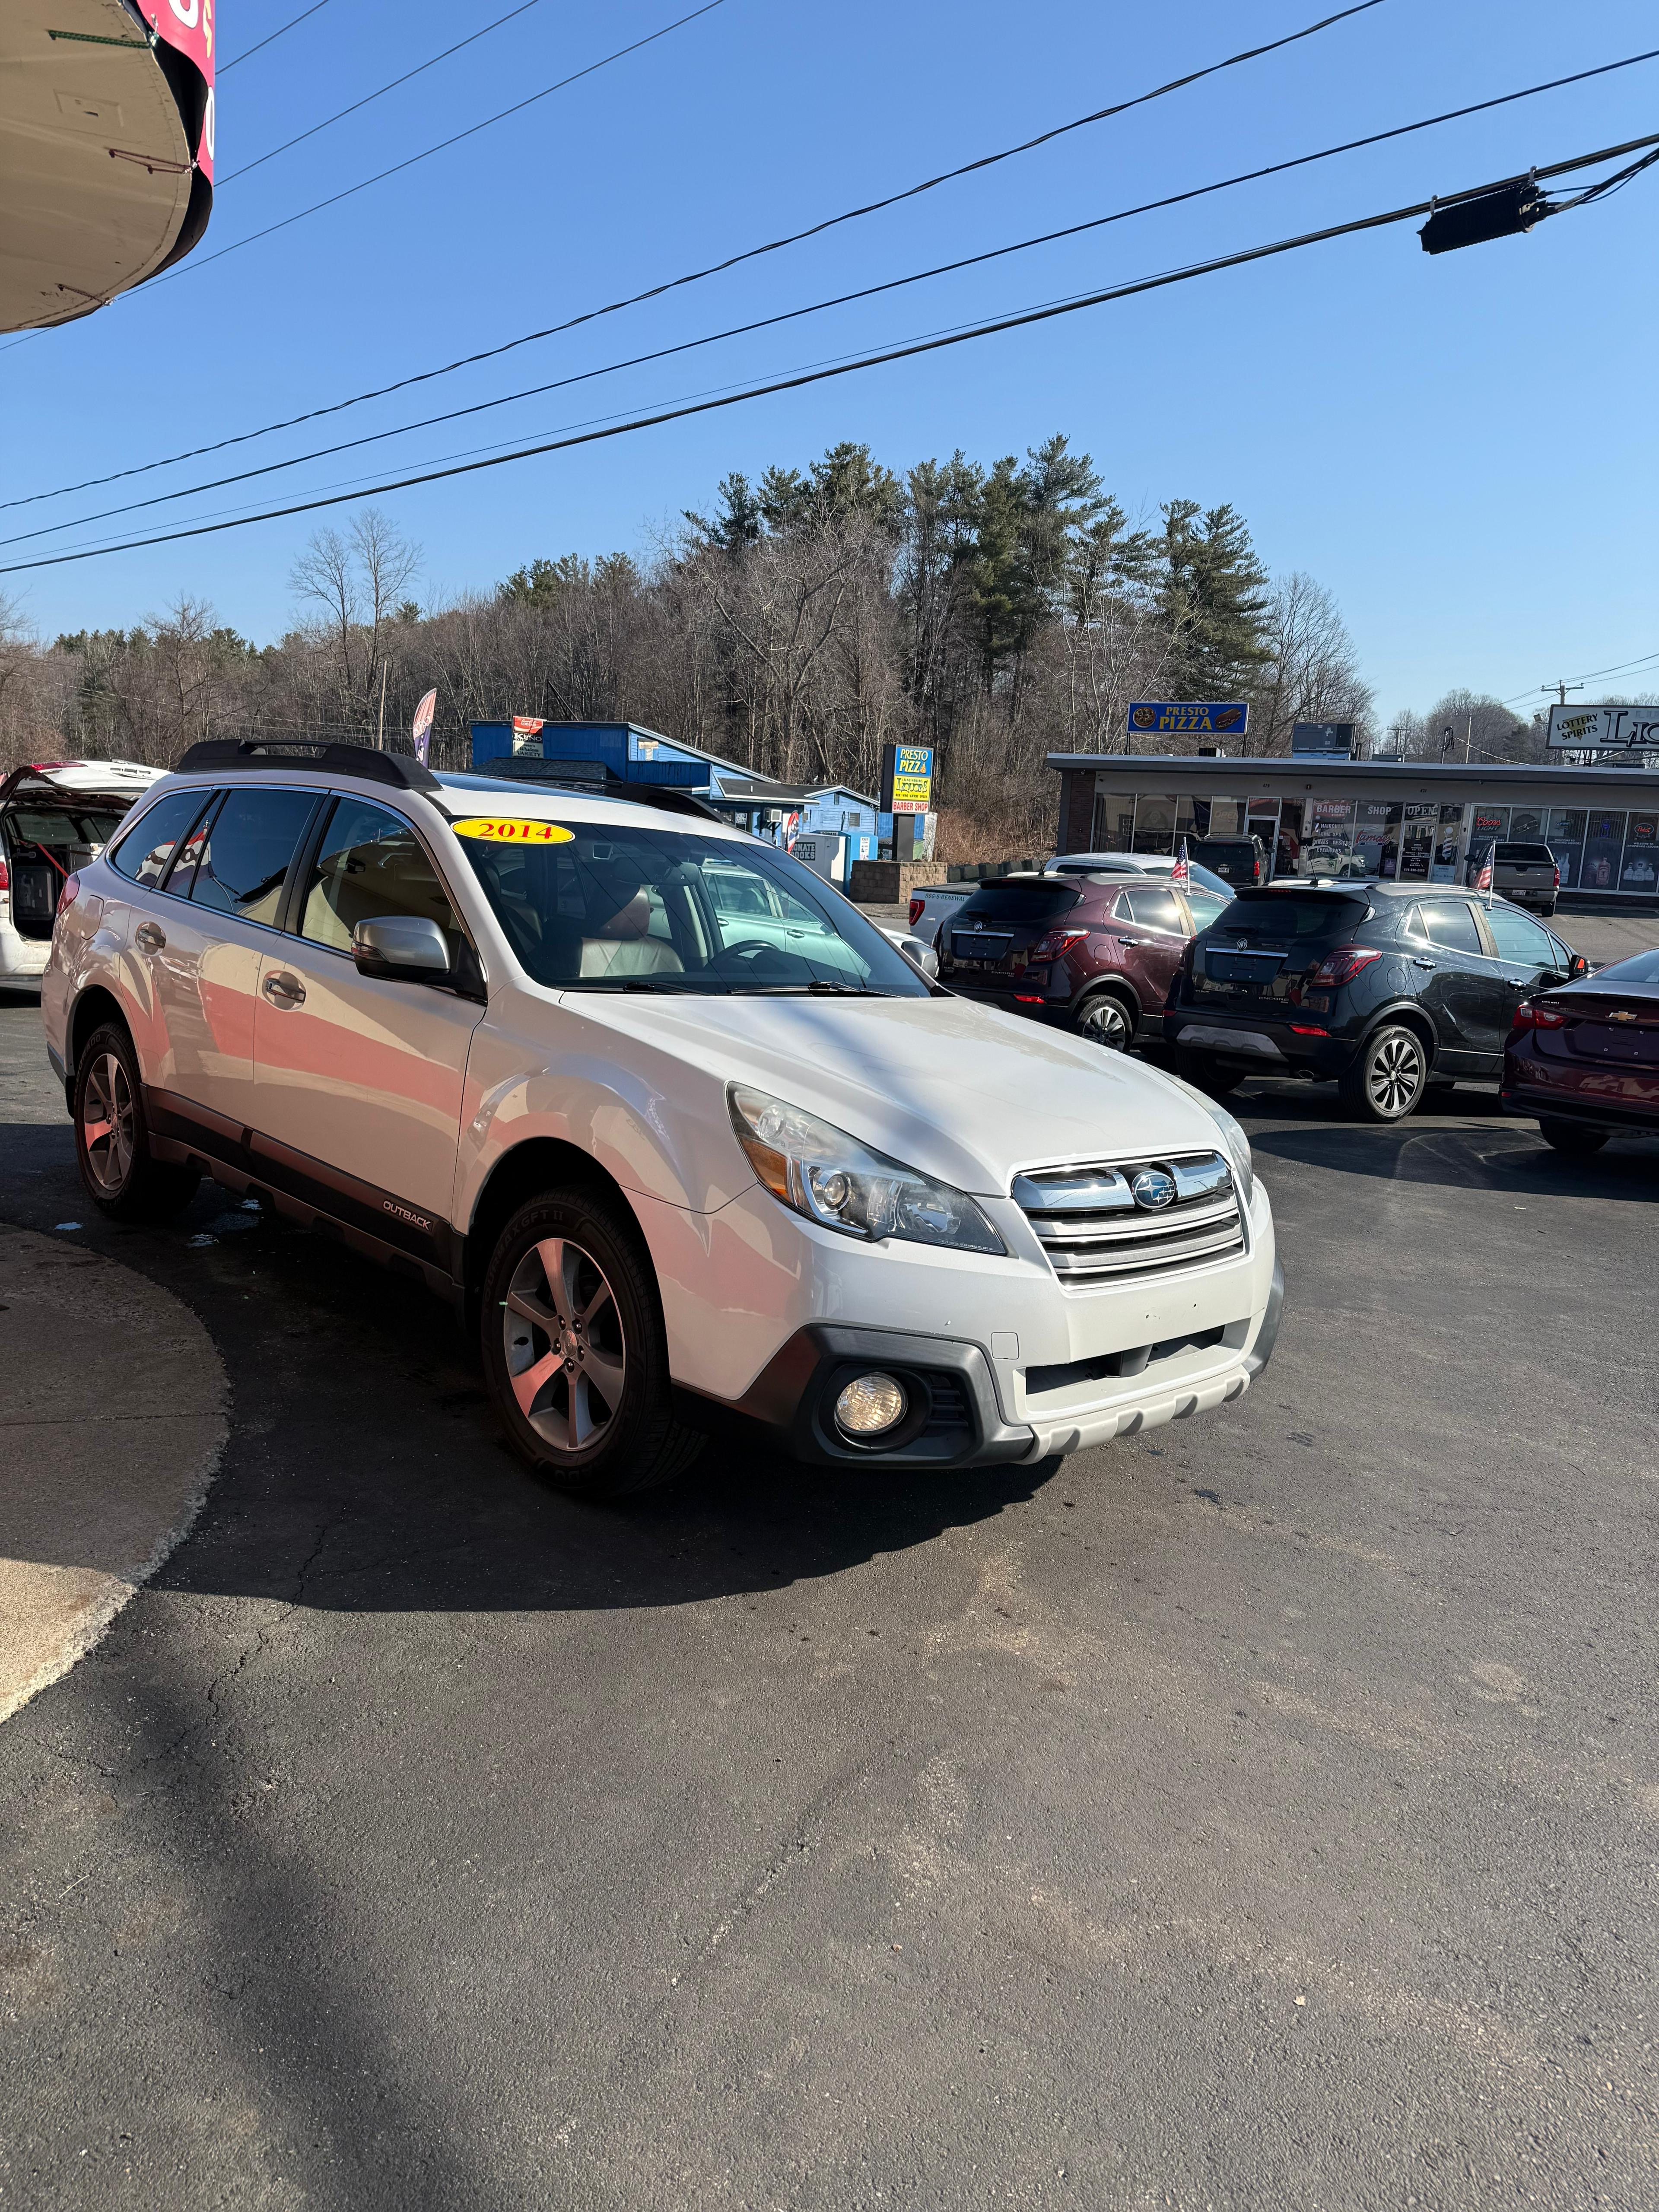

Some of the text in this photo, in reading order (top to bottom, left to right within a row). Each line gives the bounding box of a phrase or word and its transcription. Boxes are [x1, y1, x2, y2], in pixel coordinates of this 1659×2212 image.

[1166, 707, 1209, 715] PRESTO
[1159, 716, 1212, 730] PIZZA
[1557, 713, 1598, 731] LOTTERY
[1561, 725, 1598, 740] SPIRITS
[900, 749, 928, 761] PRESTO
[896, 778, 928, 793] LIQUORS
[893, 802, 928, 811] BARBER SHOP
[1317, 805, 1392, 815] BARBER SHOP
[1407, 806, 1434, 816] OPEN
[1477, 817, 1501, 826] Coors
[478, 823, 553, 839] 2014
[383, 1201, 431, 1231] OUTBACK
